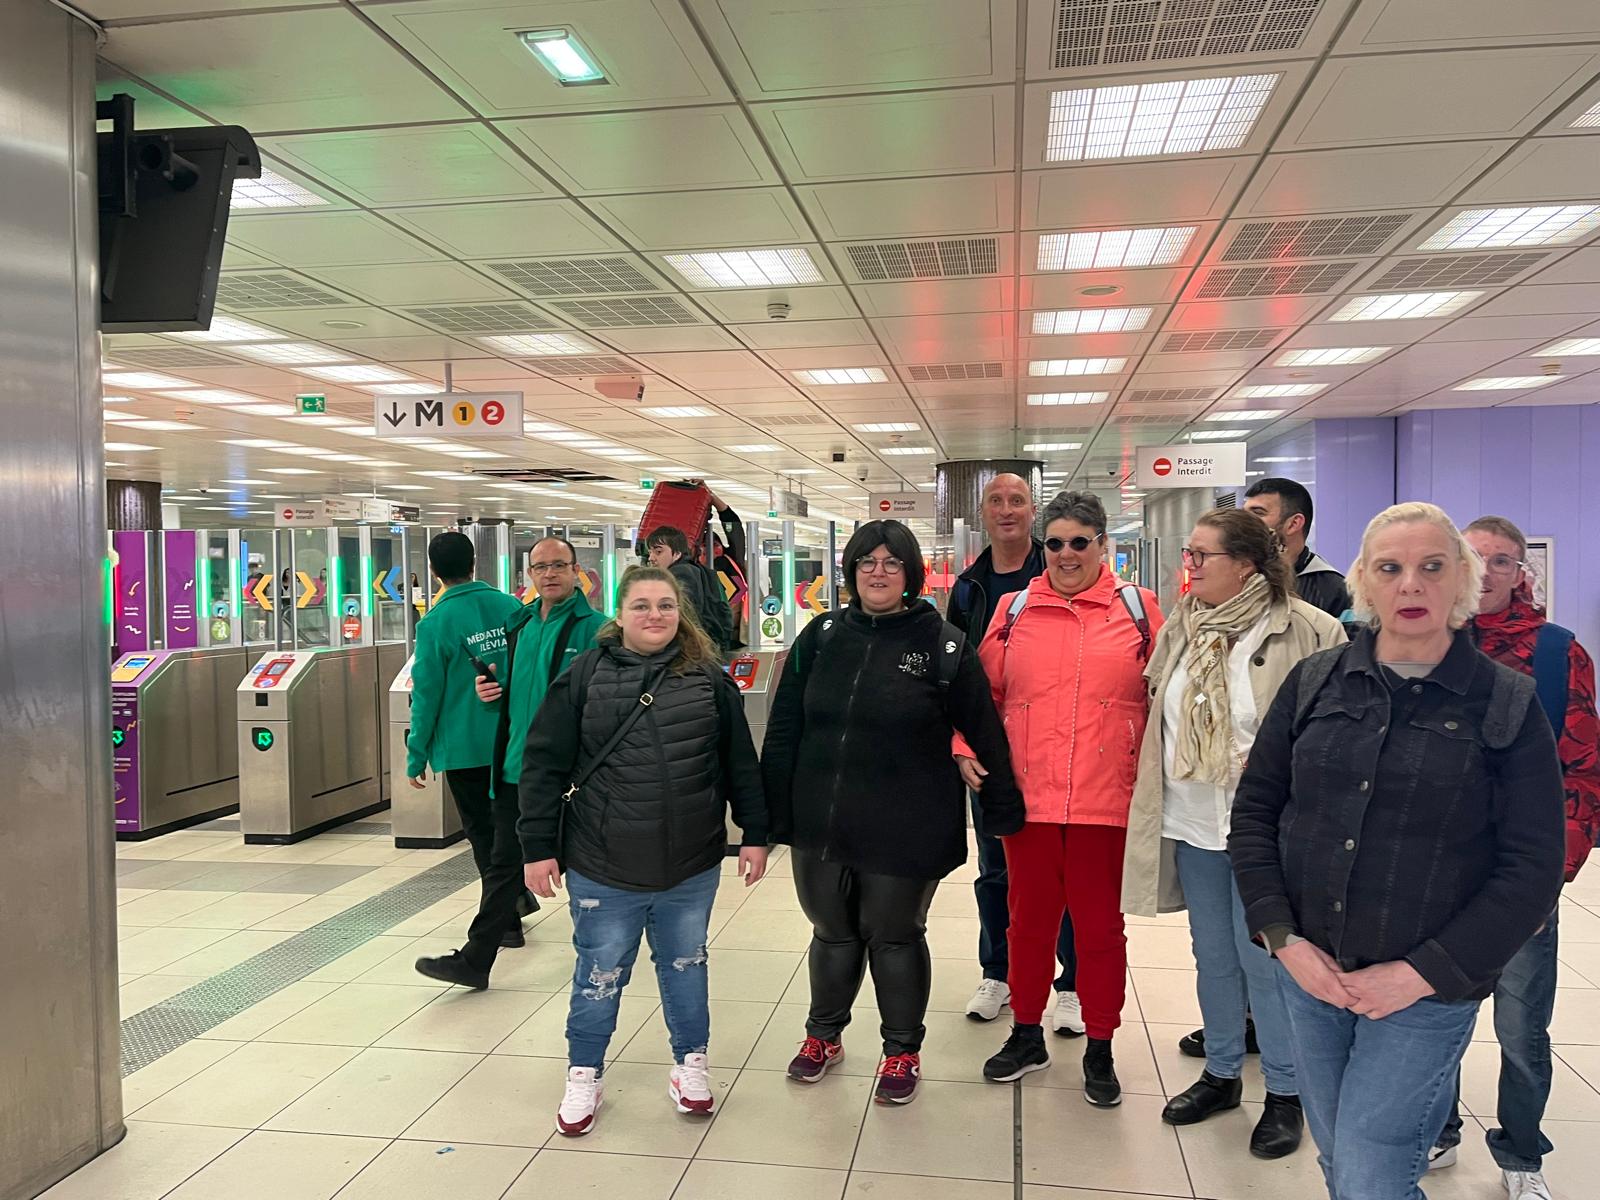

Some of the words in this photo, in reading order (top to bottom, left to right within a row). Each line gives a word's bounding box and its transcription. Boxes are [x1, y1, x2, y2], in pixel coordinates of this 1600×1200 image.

[415, 399, 444, 427] M
[486, 405, 499, 421] 2
[1177, 457, 1214, 467] Passage
[1177, 467, 1212, 476] Interdit
